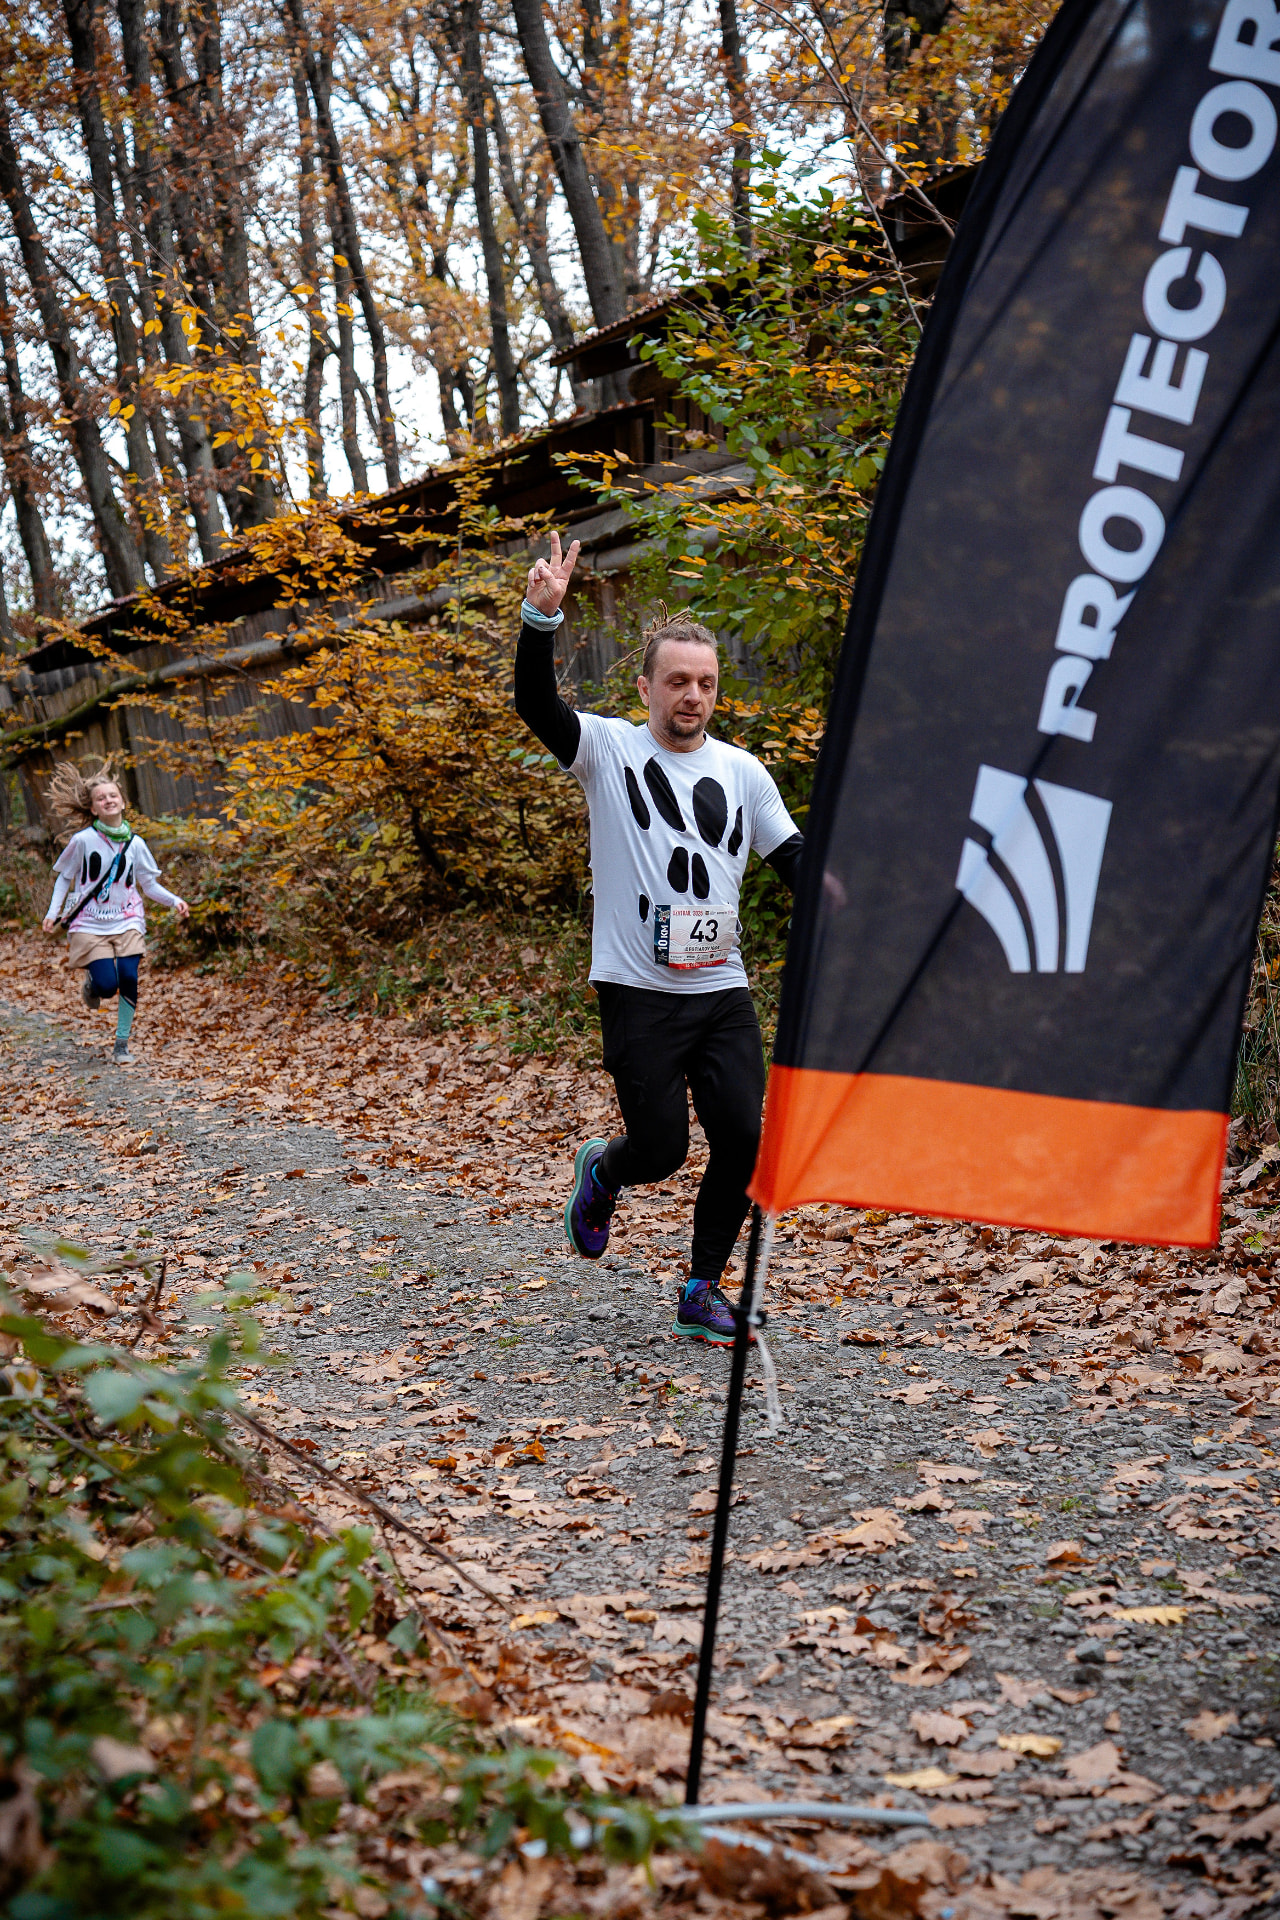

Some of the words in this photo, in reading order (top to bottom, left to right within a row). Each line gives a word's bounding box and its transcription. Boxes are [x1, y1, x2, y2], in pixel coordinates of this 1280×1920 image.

[1038, 0, 1280, 742] PROTECTOR
[660, 924, 669, 939] KM
[689, 919, 719, 943] 43
[657, 939, 669, 951] 10
